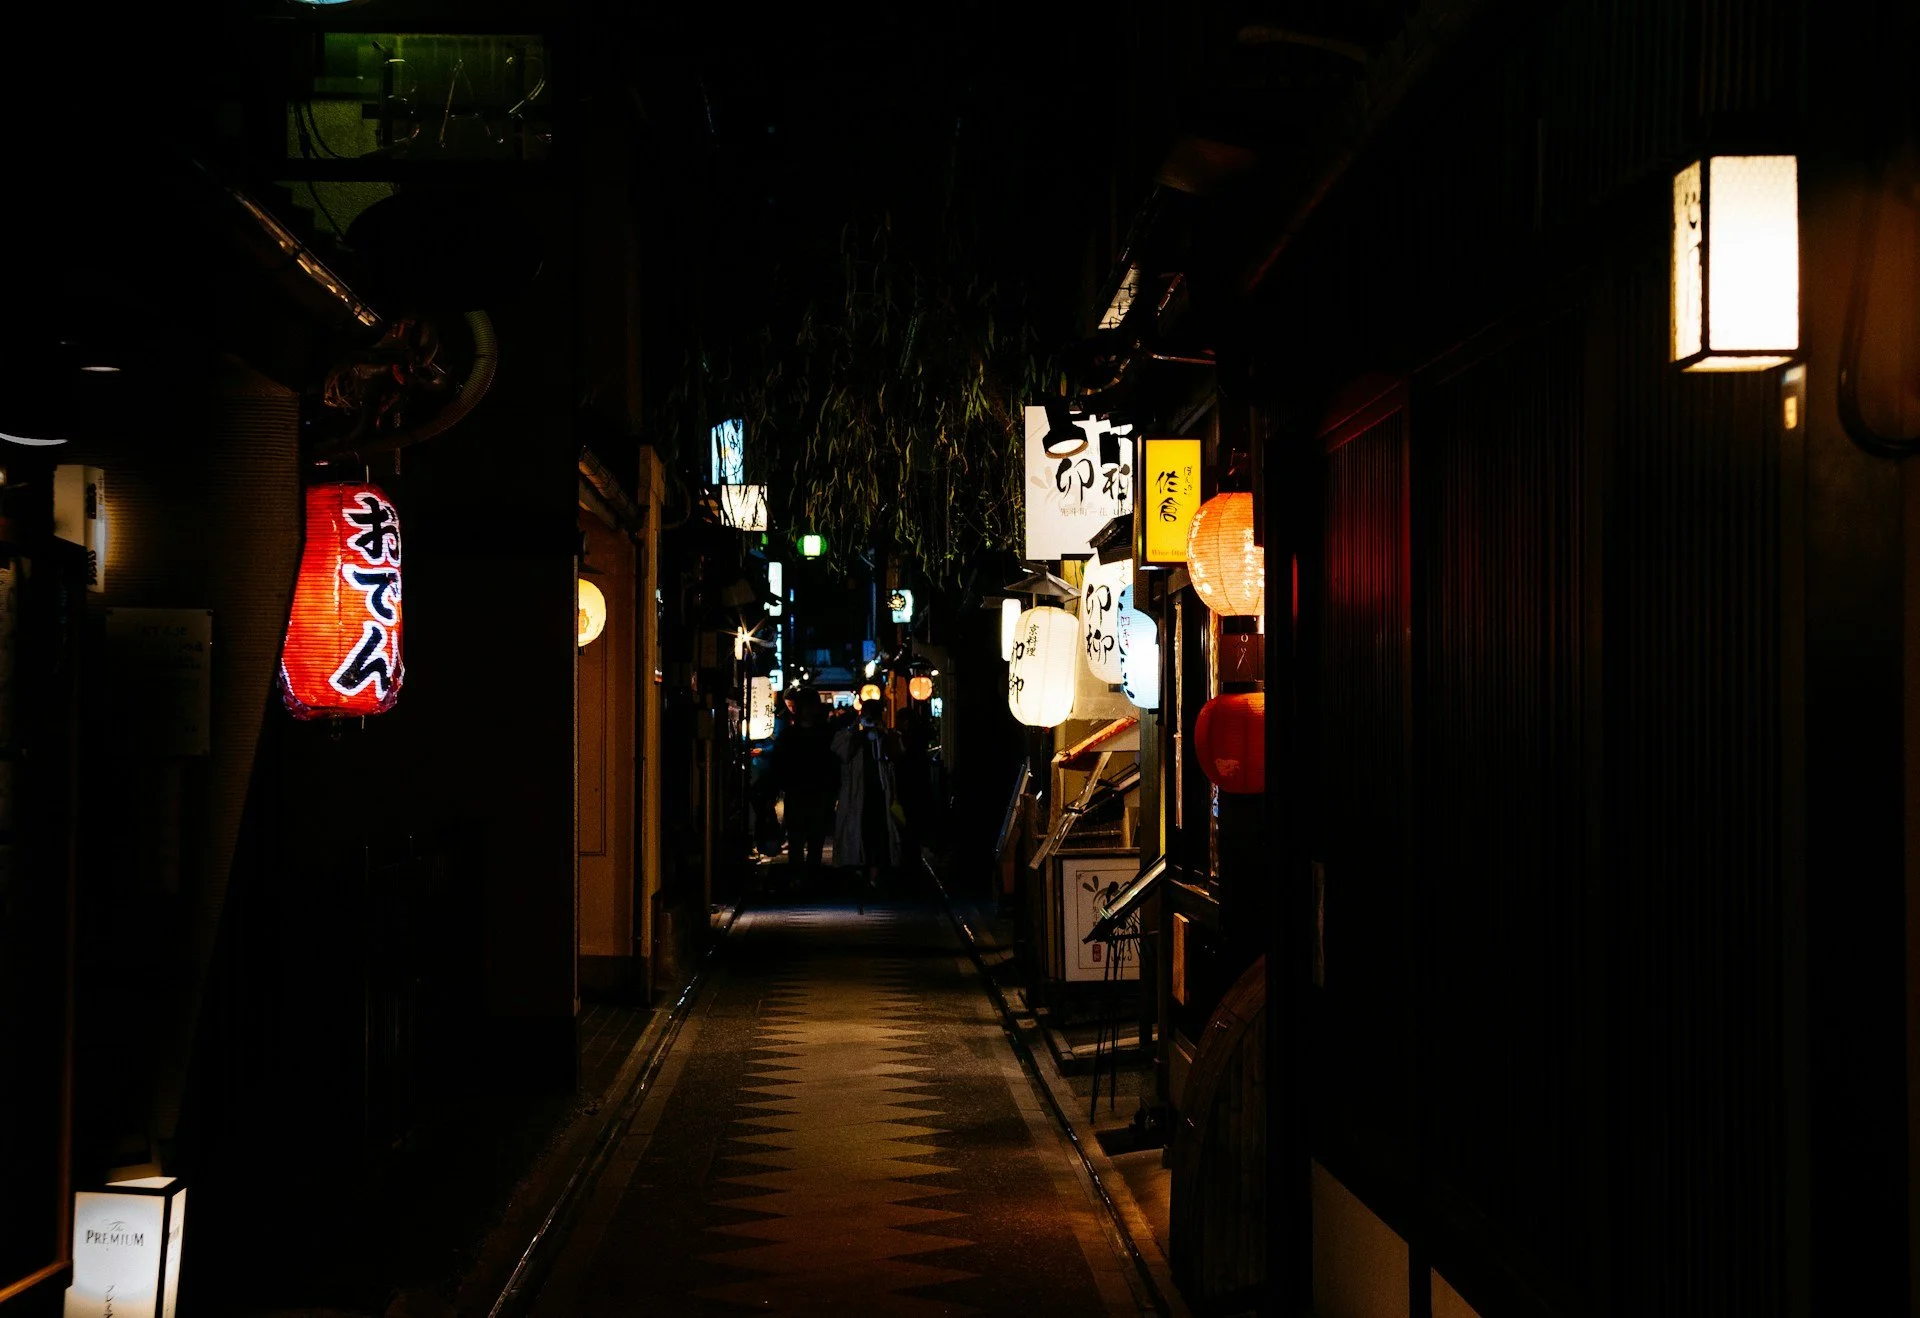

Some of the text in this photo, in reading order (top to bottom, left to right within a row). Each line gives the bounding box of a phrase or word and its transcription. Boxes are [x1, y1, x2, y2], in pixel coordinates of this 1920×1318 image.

[329, 491, 402, 701] おでん
[1085, 583, 1115, 665] 卯柳
[1025, 623, 1039, 657] 京料理
[85, 1229, 144, 1247] PREMIUM
